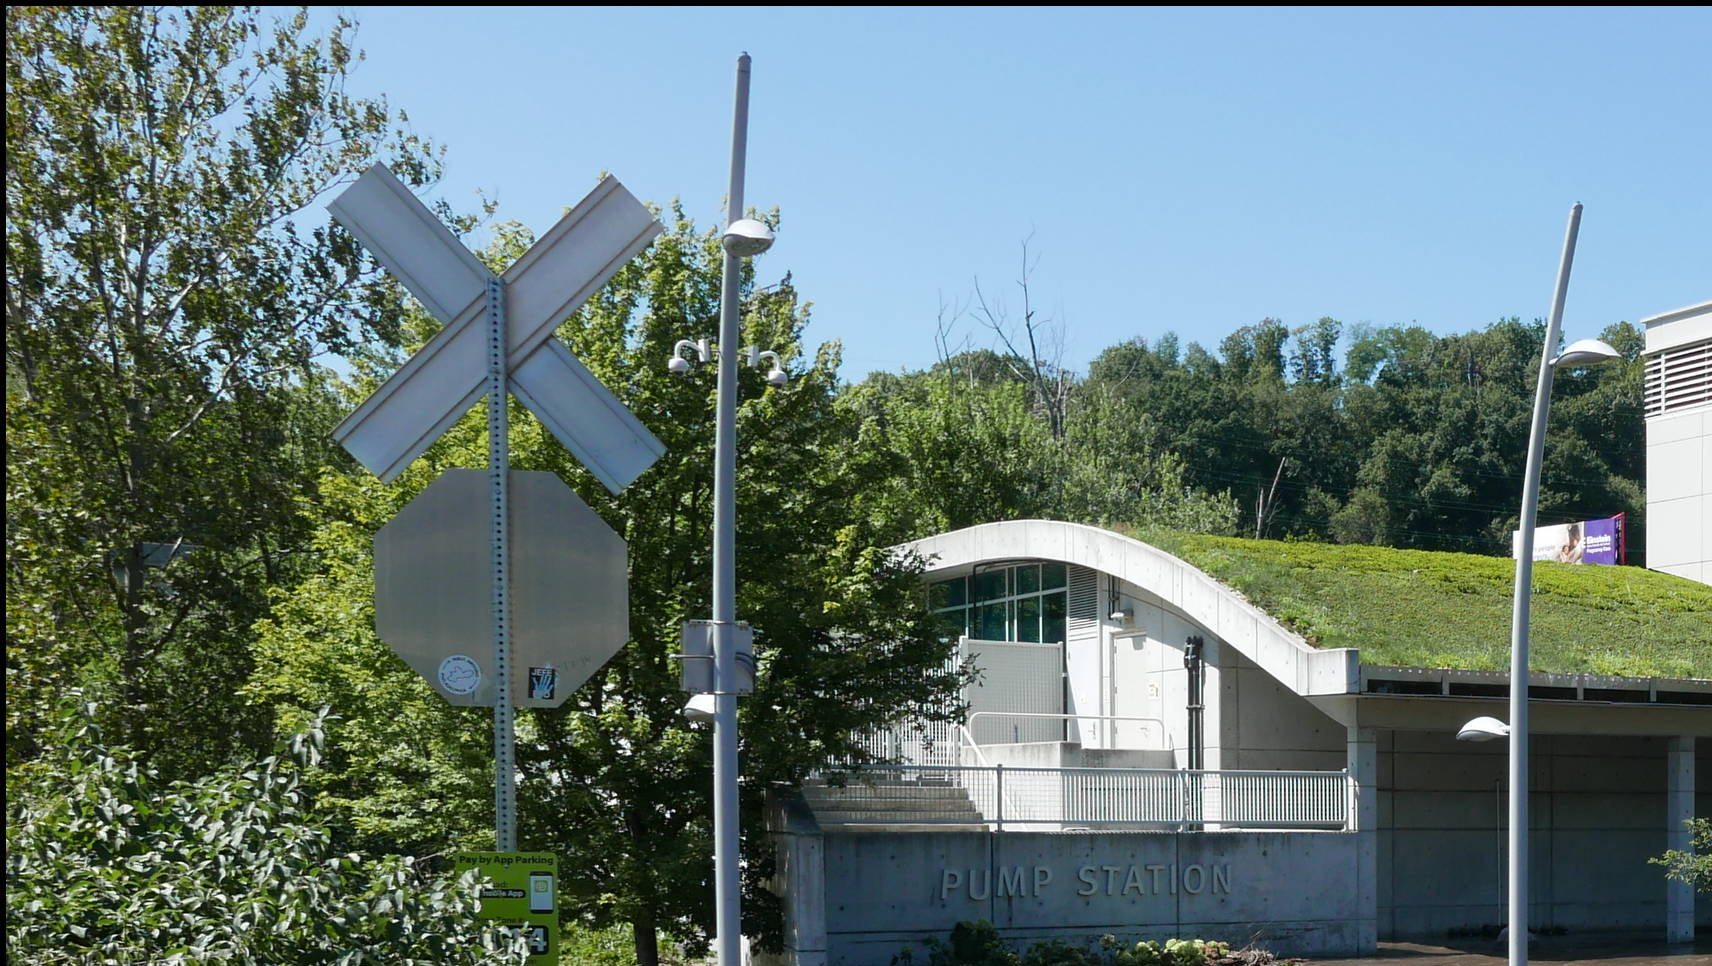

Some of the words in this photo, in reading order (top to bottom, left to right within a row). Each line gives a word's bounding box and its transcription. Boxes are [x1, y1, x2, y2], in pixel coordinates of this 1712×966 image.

[459, 855, 477, 865] Pay
[479, 855, 493, 865] by
[494, 855, 513, 865] App
[515, 855, 554, 865] Parking
[940, 865, 1053, 900] PUMP
[1077, 863, 1232, 897] STATION
